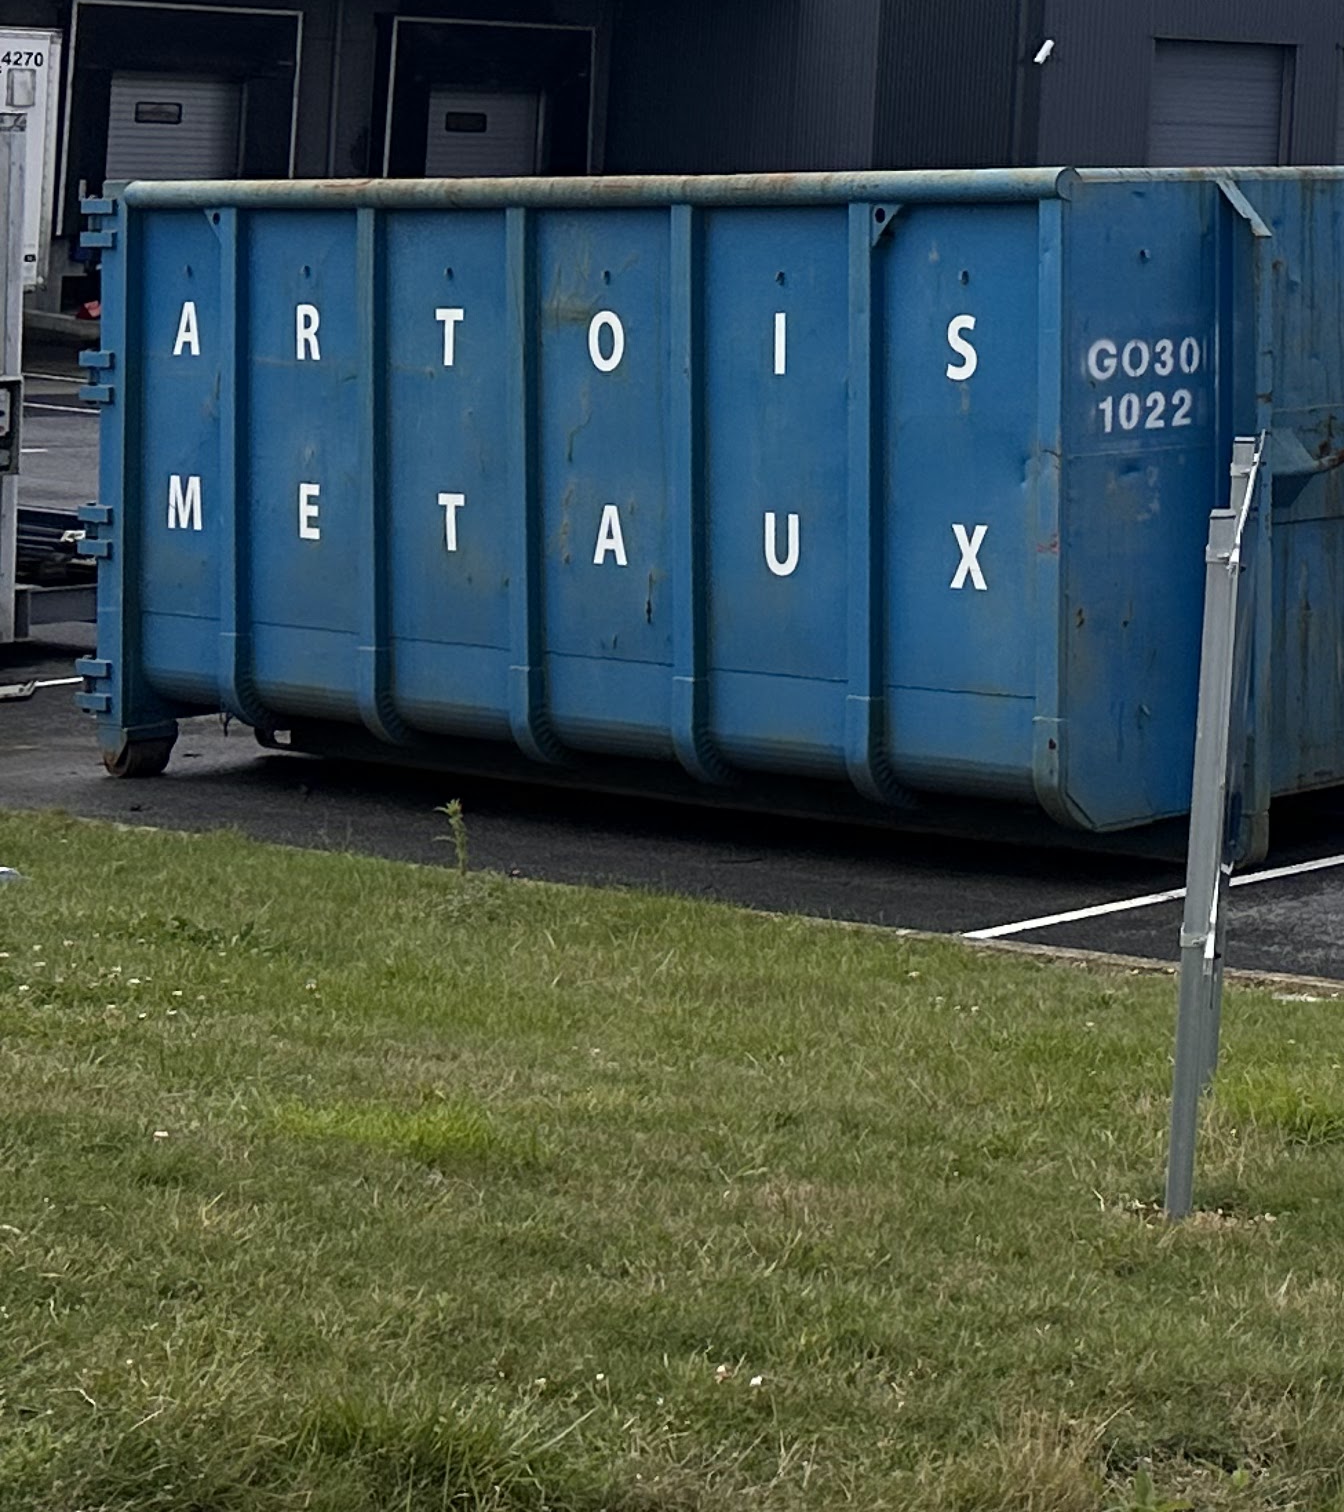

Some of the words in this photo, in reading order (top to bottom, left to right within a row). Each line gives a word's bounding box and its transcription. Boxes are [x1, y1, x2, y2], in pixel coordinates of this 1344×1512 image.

[1, 51, 44, 67] 4270
[172, 301, 980, 381] ARTOIS
[1098, 389, 1193, 433] 1022
[167, 475, 988, 591] METAUX
